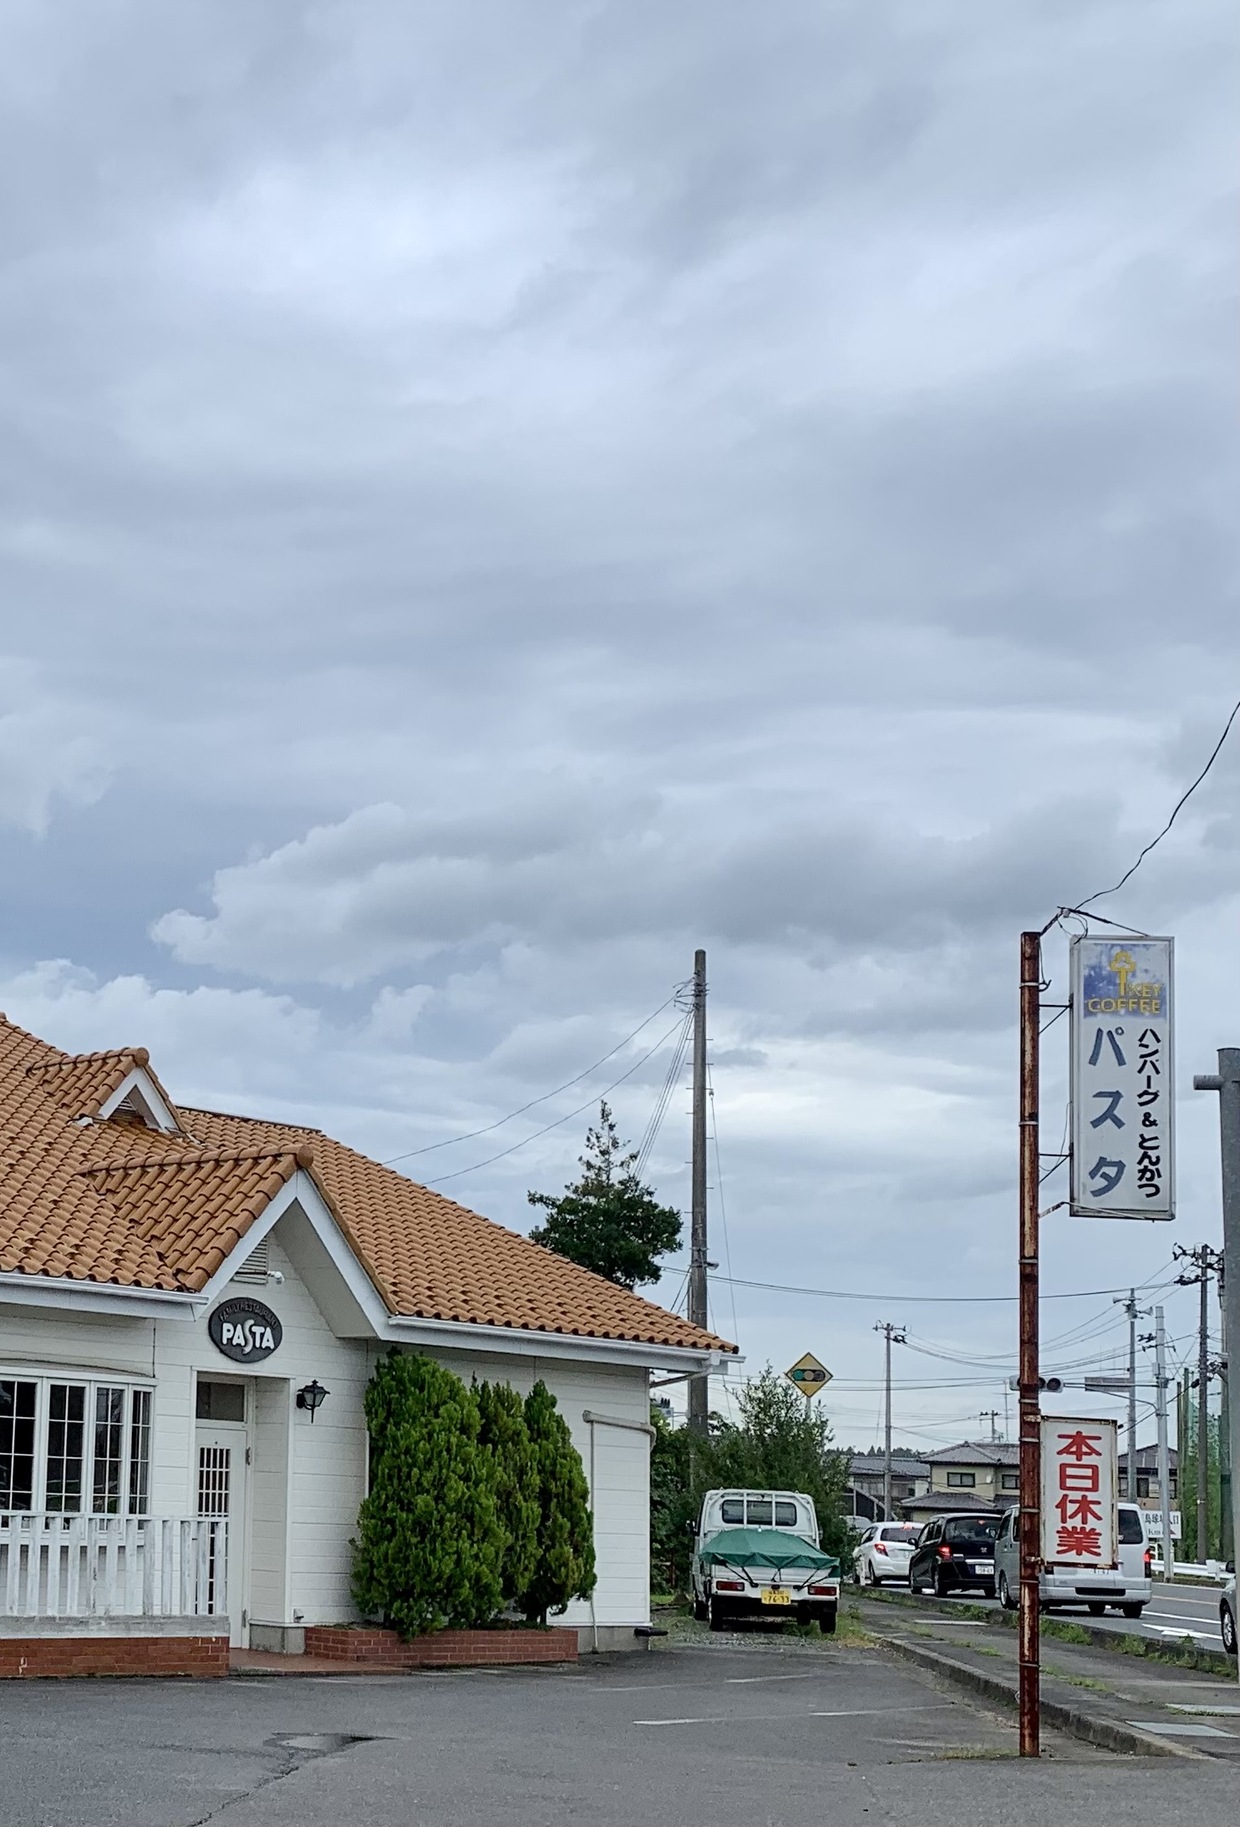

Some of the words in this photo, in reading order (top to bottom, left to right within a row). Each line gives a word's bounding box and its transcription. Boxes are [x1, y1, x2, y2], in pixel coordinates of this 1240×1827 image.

[1088, 998, 1161, 1014] COFFEE
[1088, 1026, 1127, 1198] パスタ
[222, 1319, 275, 1354] PASTA
[1055, 1430, 1103, 1557] 本日休業
